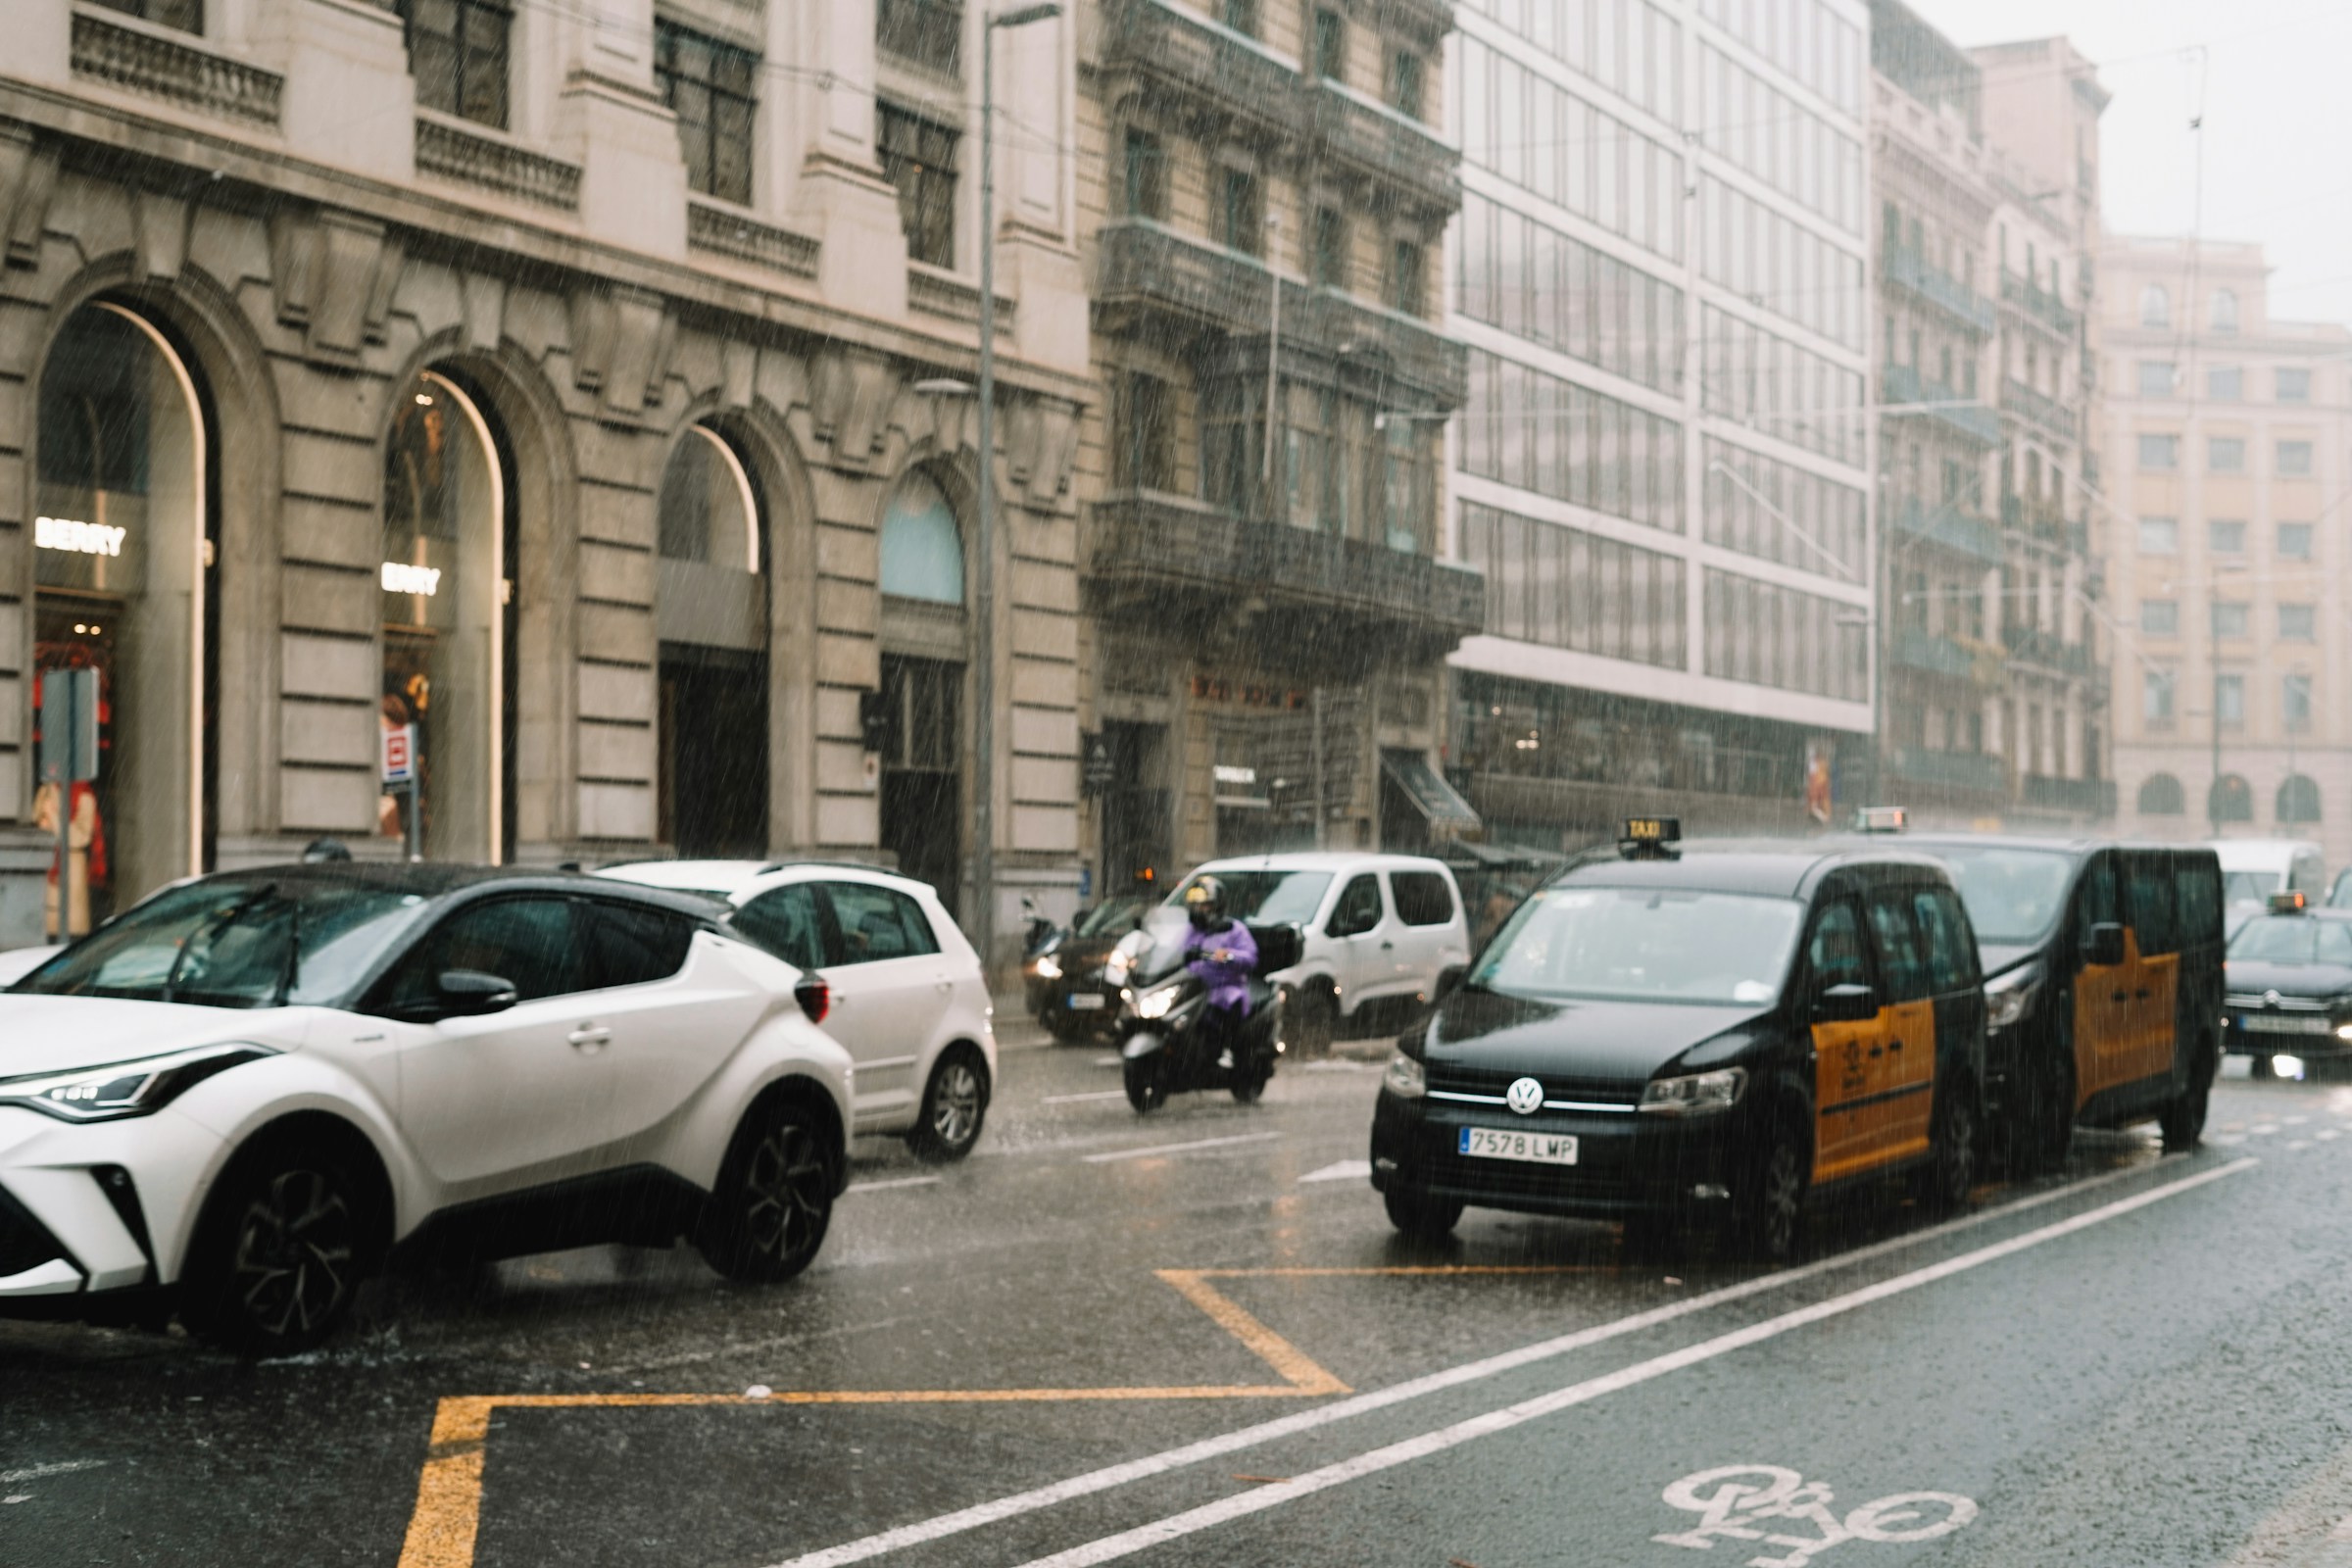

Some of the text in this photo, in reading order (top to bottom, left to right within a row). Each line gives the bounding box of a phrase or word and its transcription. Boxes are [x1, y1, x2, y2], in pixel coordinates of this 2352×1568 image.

[1630, 819, 1660, 839] TAXI
[1474, 1131, 1573, 1158] 7578 LWP
